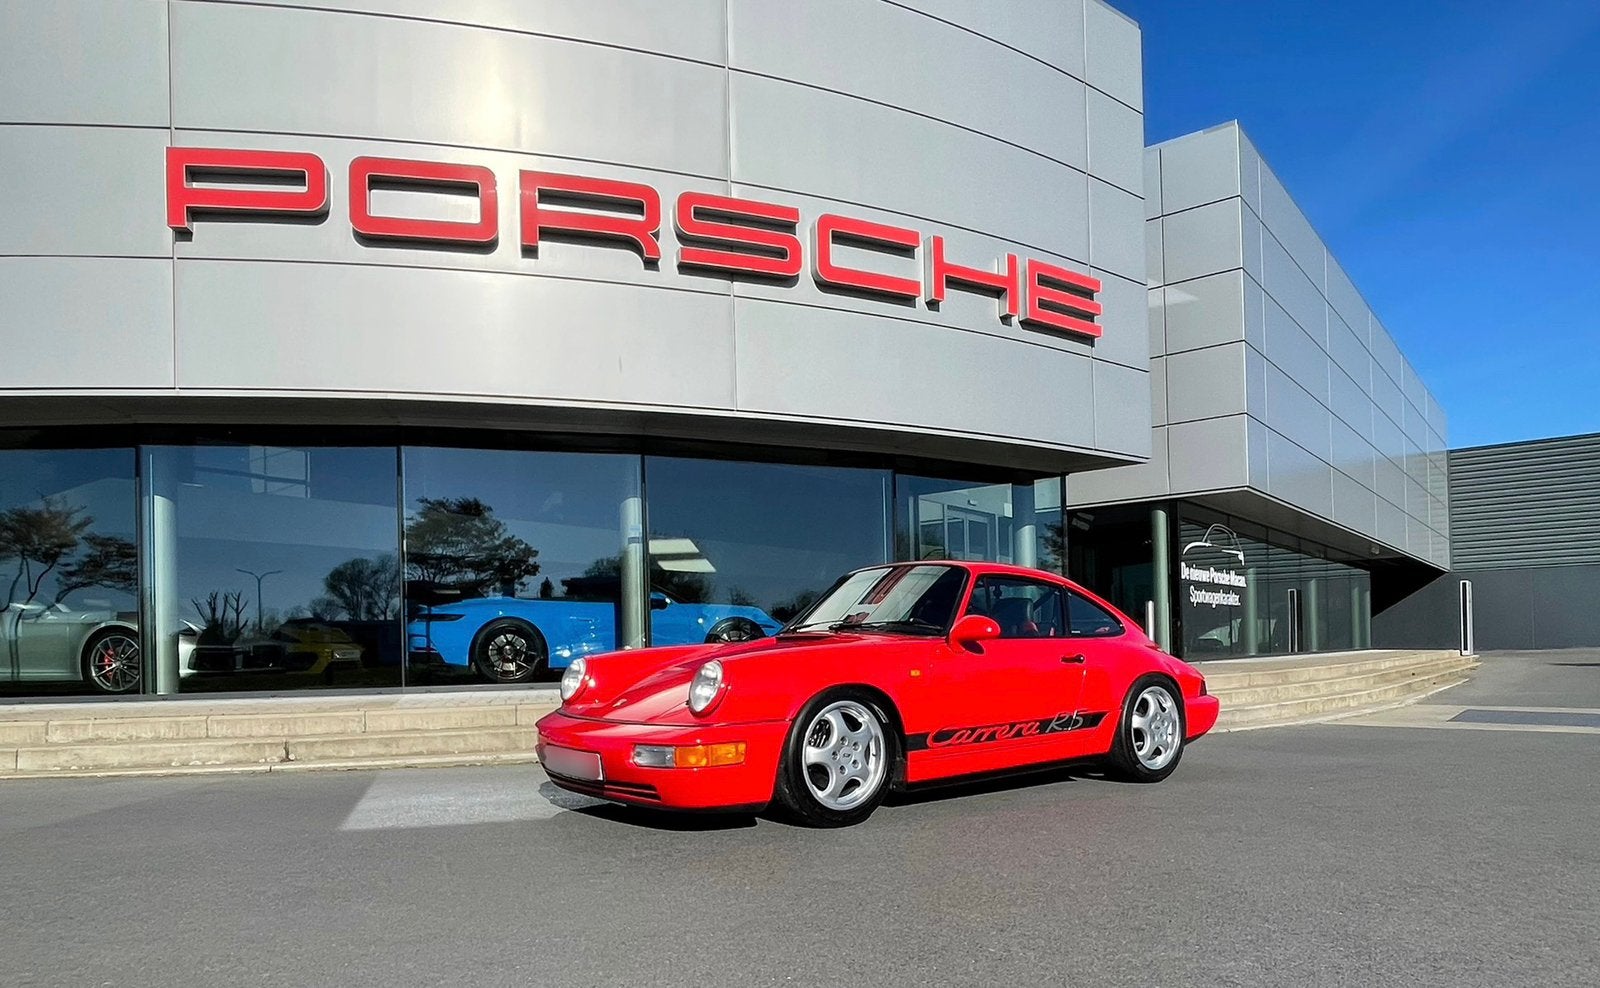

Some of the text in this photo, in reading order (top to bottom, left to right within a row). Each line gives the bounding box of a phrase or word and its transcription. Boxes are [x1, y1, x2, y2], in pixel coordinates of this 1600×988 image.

[166, 146, 1103, 338] PORSCHE
[1181, 562, 1189, 579] De
[1190, 564, 1209, 582] nieuwe
[1210, 566, 1230, 585] Porsche
[927, 719, 1041, 749] Carrera
